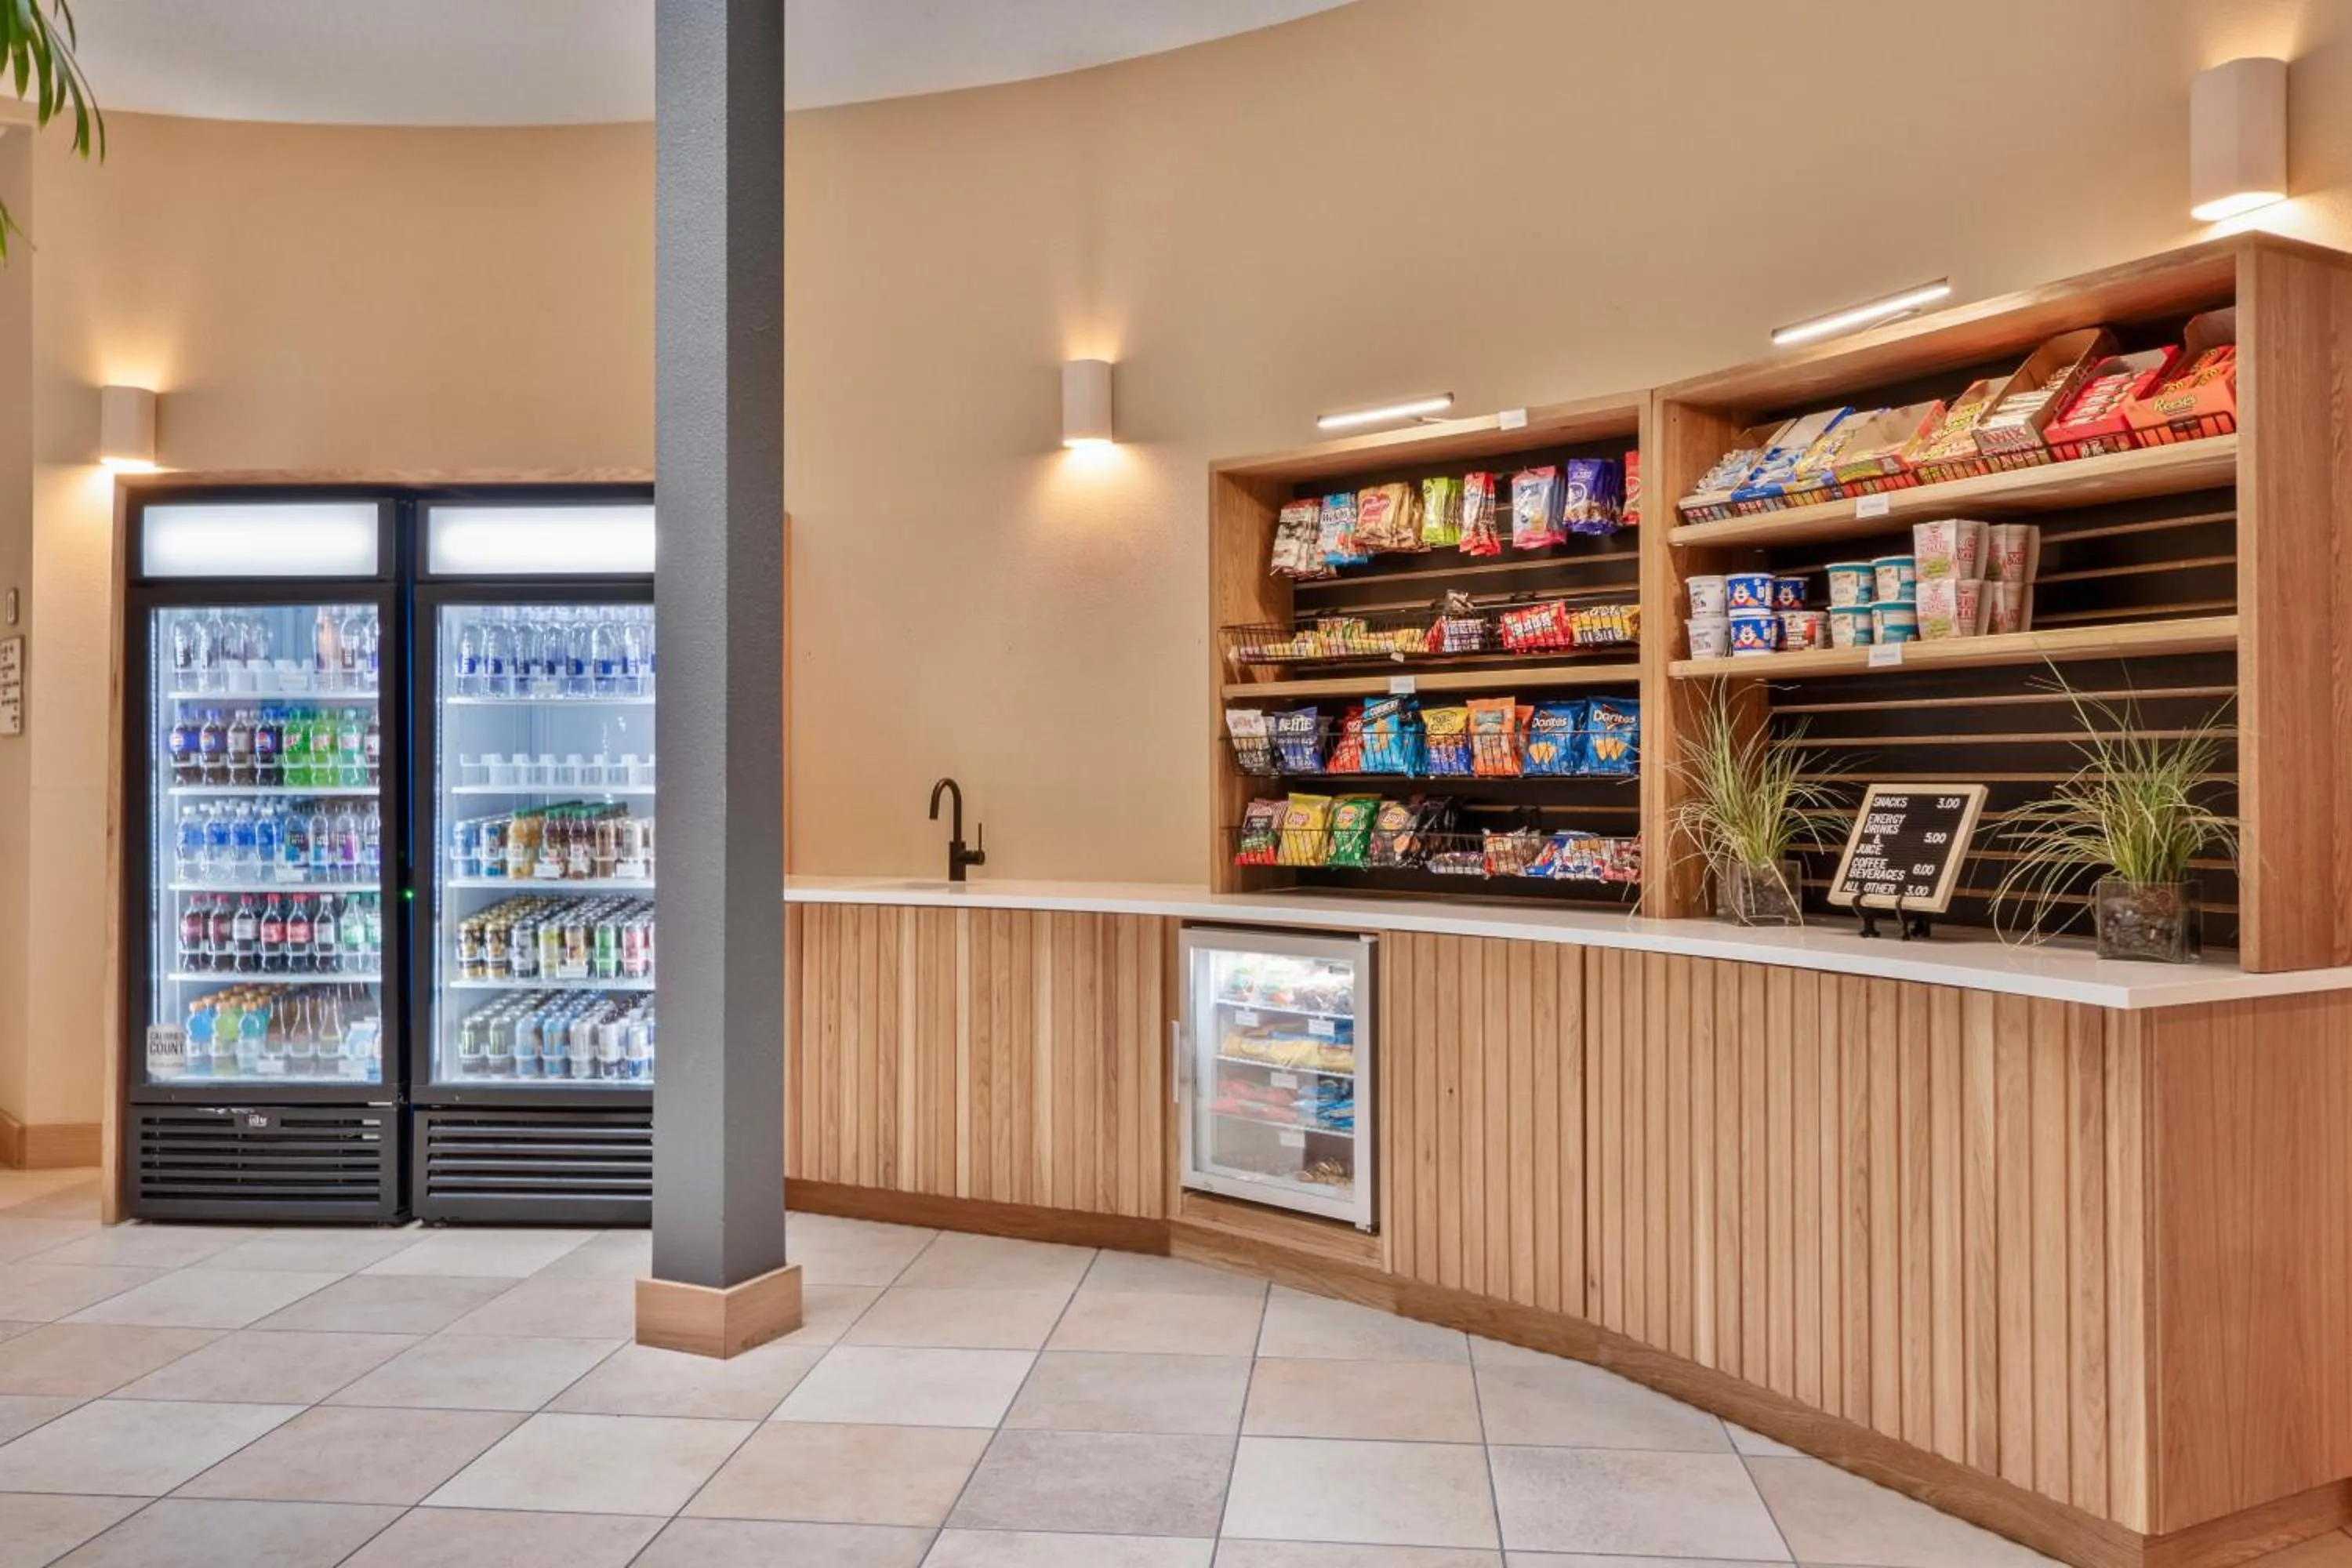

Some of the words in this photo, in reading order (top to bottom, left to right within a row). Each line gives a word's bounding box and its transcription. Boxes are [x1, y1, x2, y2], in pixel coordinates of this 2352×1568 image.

[1531, 717, 1567, 728] Doritos
[1592, 709, 1636, 723] Doritos
[1872, 796, 1909, 808] SNACKS
[1936, 797, 1961, 809] 3.00
[1867, 812, 1907, 825] ENERGY
[1864, 824, 1900, 835] DRINKS
[1923, 832, 1947, 844] 5.00
[1872, 833, 1882, 844] &
[1856, 843, 1884, 855] JUICE
[1851, 857, 1889, 870] COFFEE
[1912, 863, 1936, 877] 6.00
[1848, 869, 1906, 881] BEVERAGES
[1843, 880, 1860, 892] ALL
[1864, 881, 1897, 895] OTHER
[1904, 884, 1929, 897] 3.00
[149, 1040, 184, 1055] COUNT
